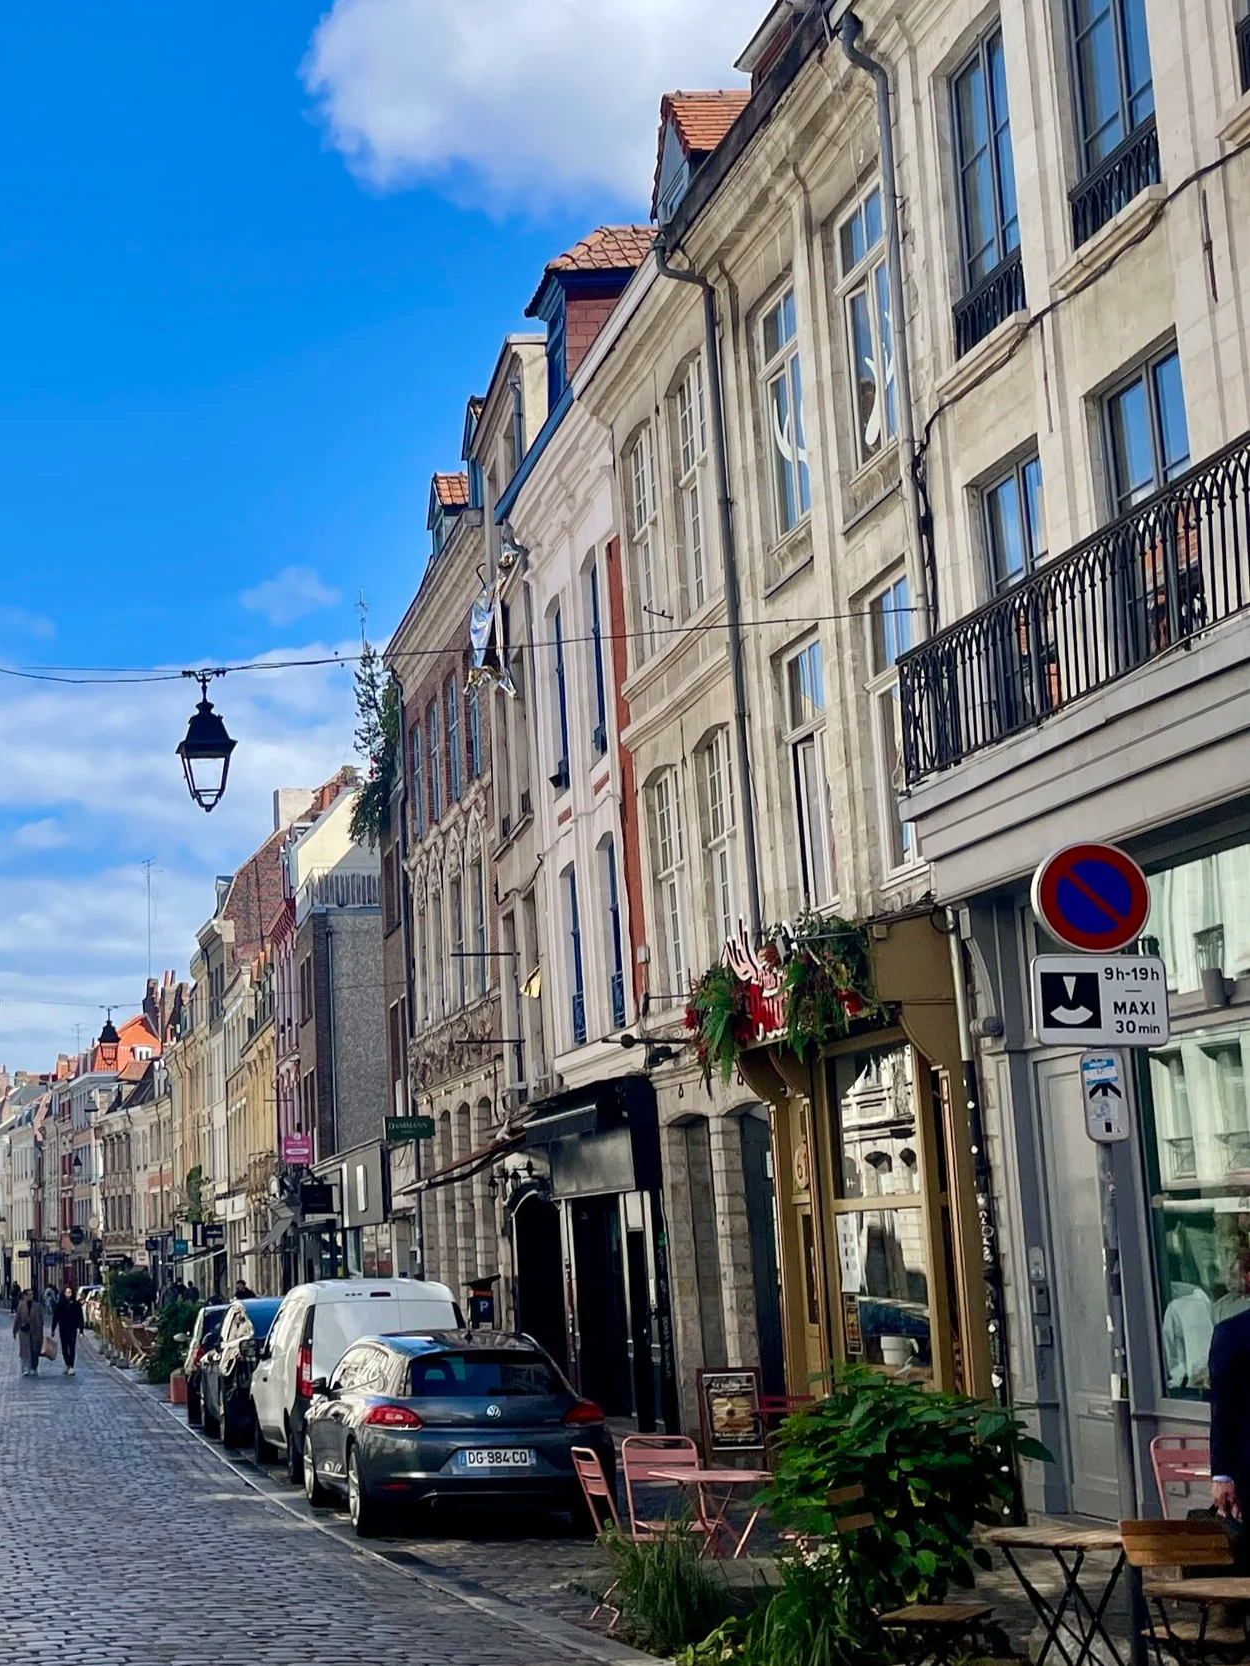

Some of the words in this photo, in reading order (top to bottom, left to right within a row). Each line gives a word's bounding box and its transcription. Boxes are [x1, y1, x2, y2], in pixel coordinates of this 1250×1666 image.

[1113, 1001, 1156, 1016] MAXI
[1115, 1019, 1137, 1034] 30
[1138, 1022, 1161, 1034] min
[480, 1300, 489, 1313] P
